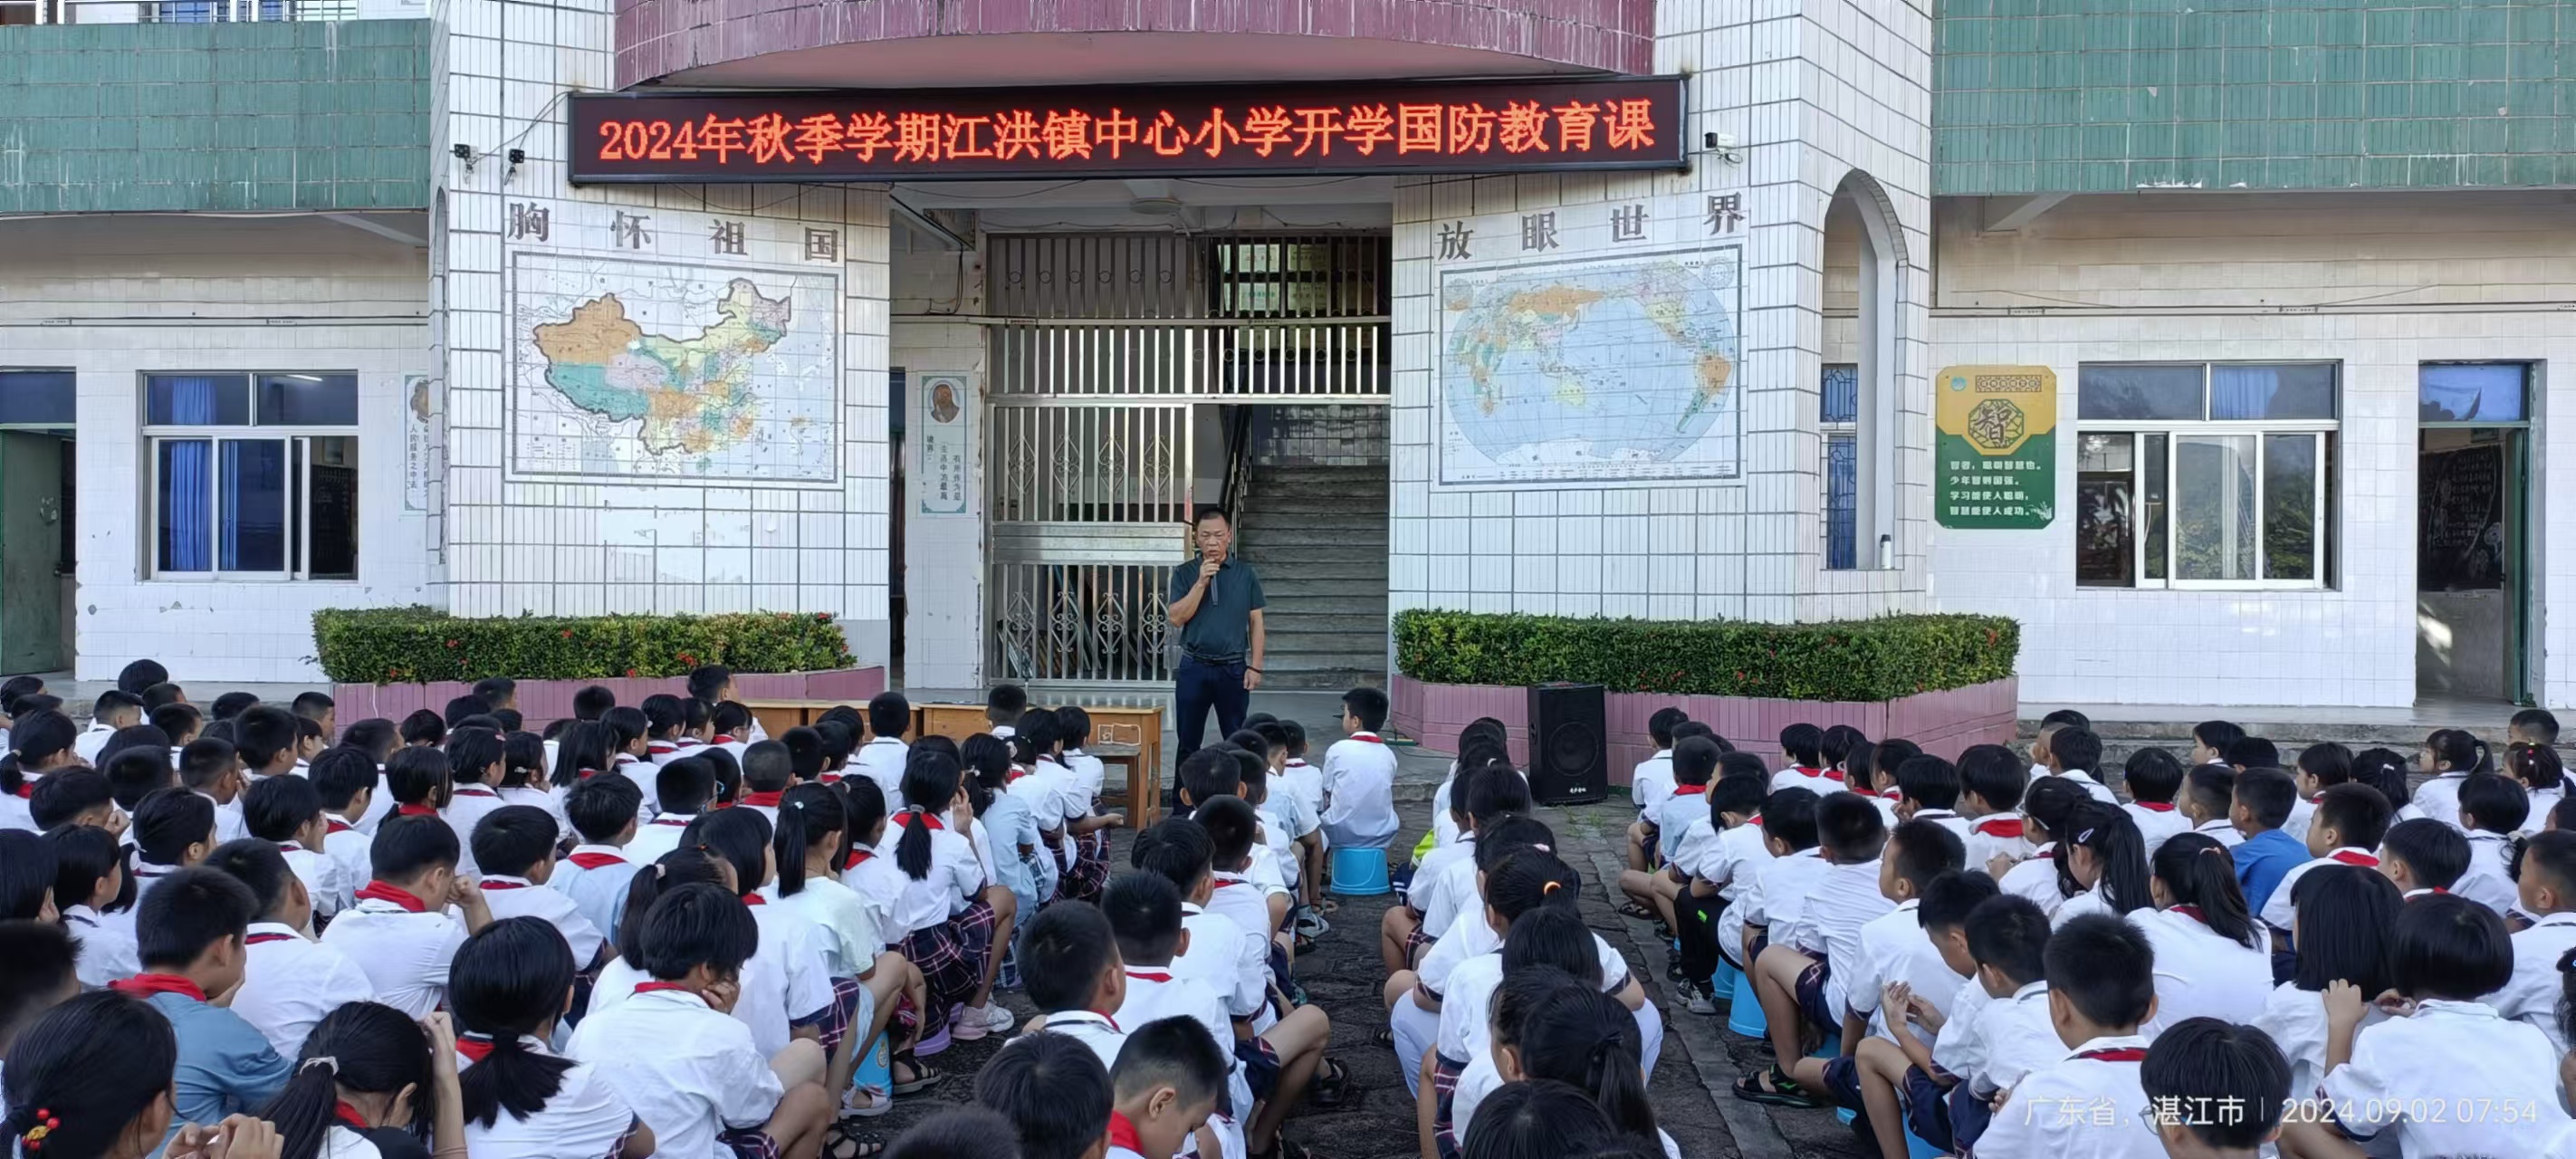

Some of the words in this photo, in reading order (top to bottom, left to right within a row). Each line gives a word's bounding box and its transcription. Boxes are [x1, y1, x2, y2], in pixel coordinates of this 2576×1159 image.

[599, 99, 1655, 164] 2024年秋季学期江洪镇中心小学开学国防教育课
[507, 201, 838, 263] 胸怀祖国
[1437, 192, 1745, 262] 放眼世界
[1973, 407, 2012, 444] 智
